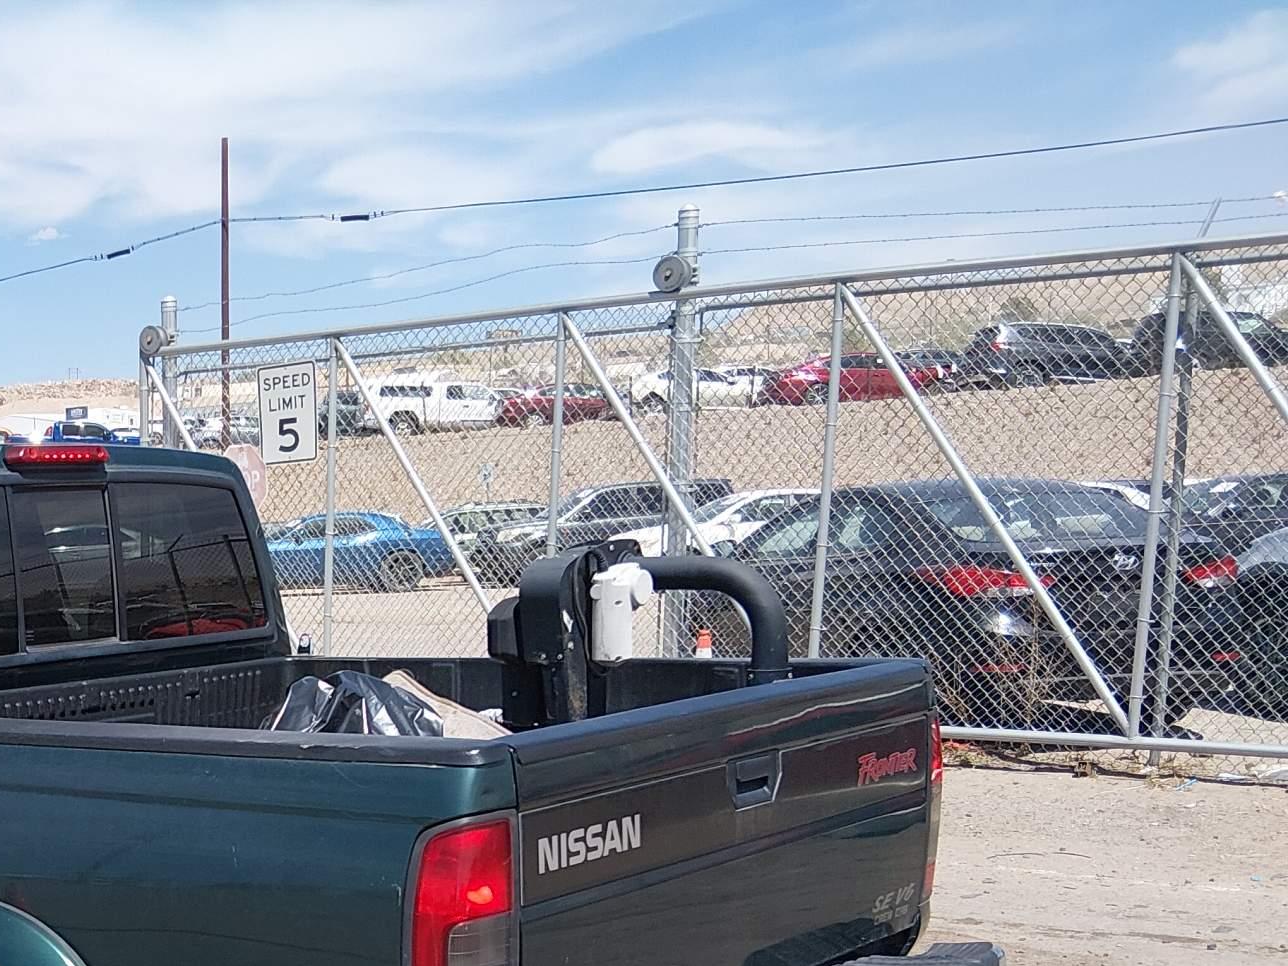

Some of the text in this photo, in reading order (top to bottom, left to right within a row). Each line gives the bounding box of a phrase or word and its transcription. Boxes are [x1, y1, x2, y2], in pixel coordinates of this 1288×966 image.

[263, 372, 311, 392] SPEED
[268, 394, 306, 412] LIMIT
[278, 417, 300, 453] 5
[537, 813, 641, 875] NISSAN
[872, 882, 915, 912] SE V6
